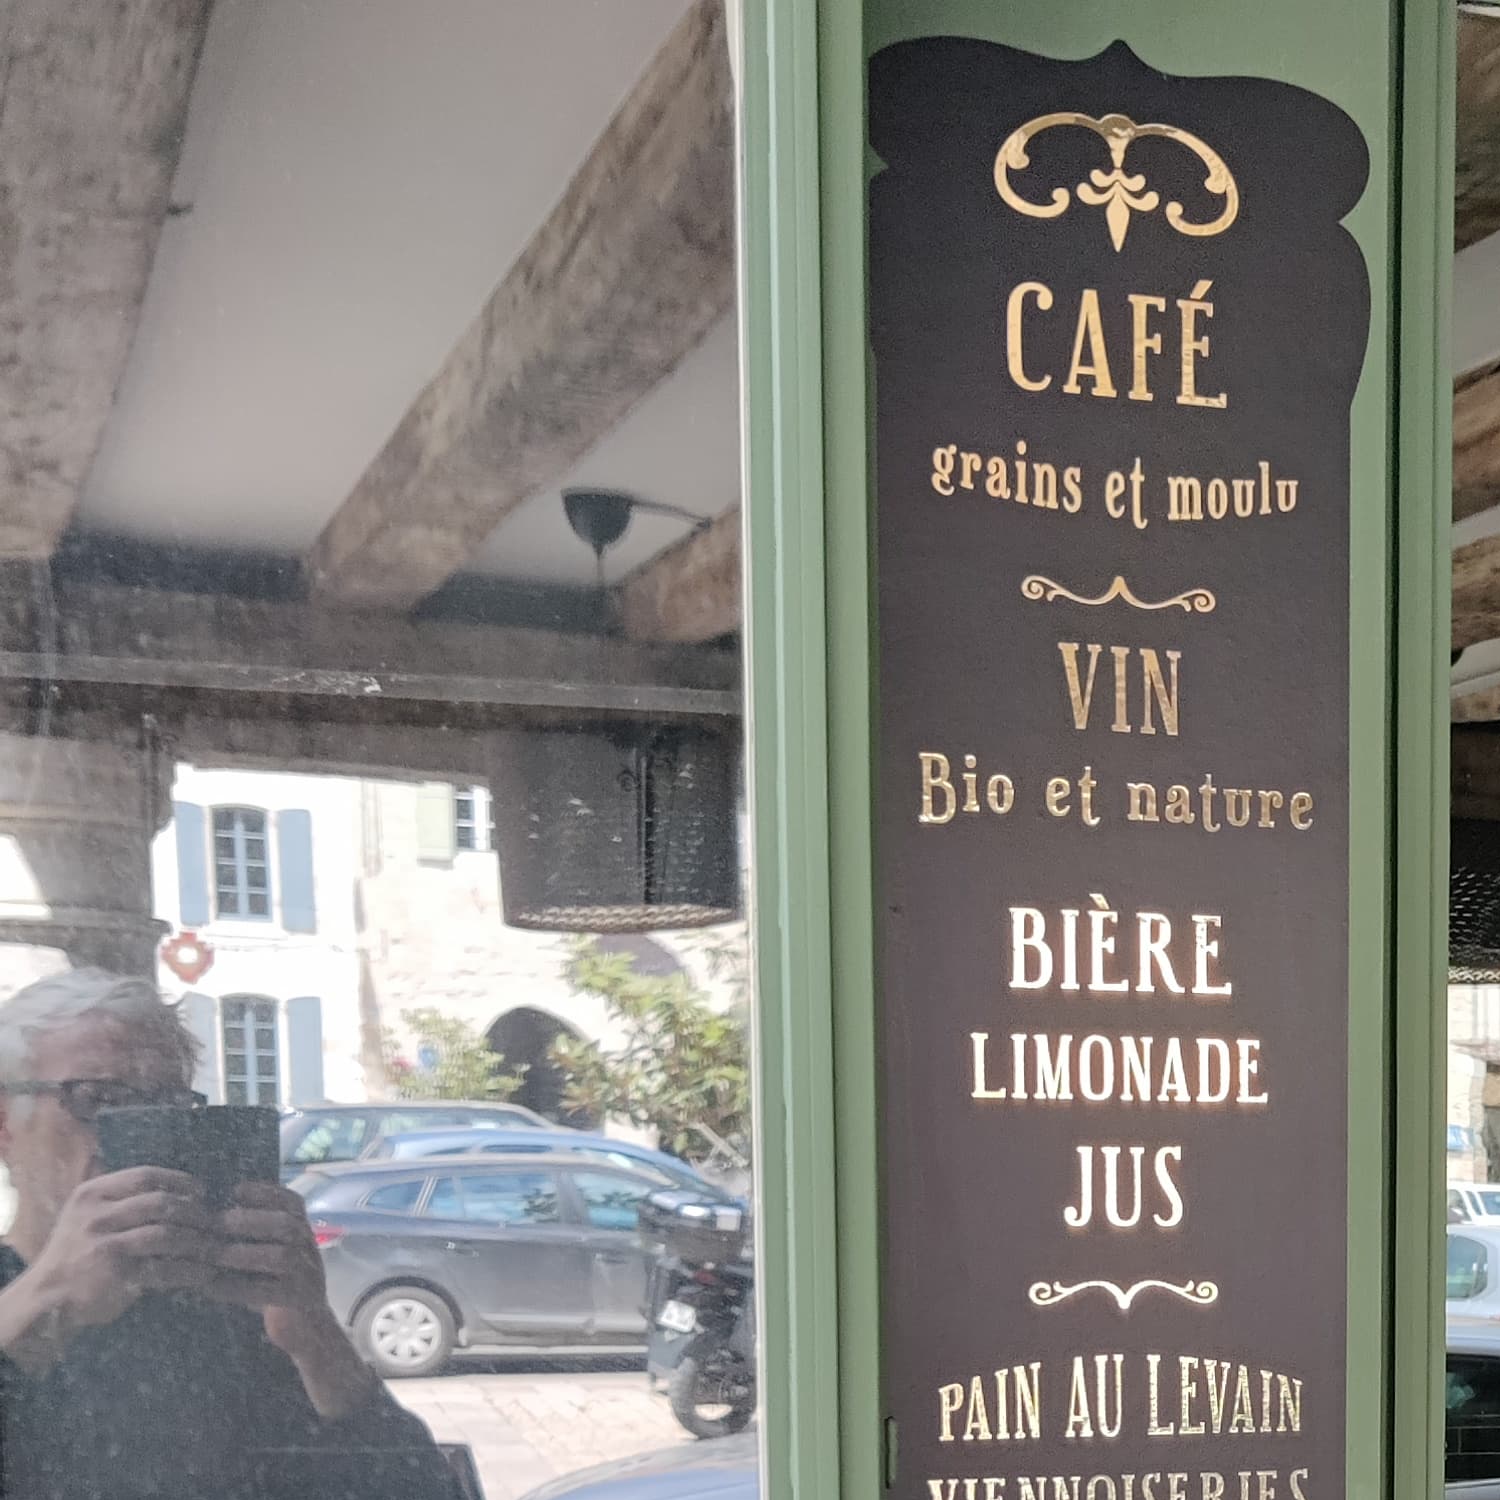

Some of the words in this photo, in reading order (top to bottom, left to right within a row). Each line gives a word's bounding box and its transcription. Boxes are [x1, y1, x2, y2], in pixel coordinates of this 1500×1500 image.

[1006, 279, 1228, 409] CAFÉ
[931, 440, 1082, 514] grains
[1104, 457, 1148, 530] et
[1167, 460, 1299, 521] moulu
[1057, 641, 1182, 736] VIN
[918, 751, 1015, 824] Bio
[1045, 765, 1101, 827] et
[1126, 773, 1314, 833] nature
[1008, 893, 1233, 996] BIÈRE
[970, 1032, 1269, 1104] LIMONADE
[1063, 1145, 1184, 1228] JUS
[938, 1361, 1042, 1442] PAIN
[1065, 1353, 1124, 1438] AU
[1146, 1353, 1303, 1436] LEVAIN
